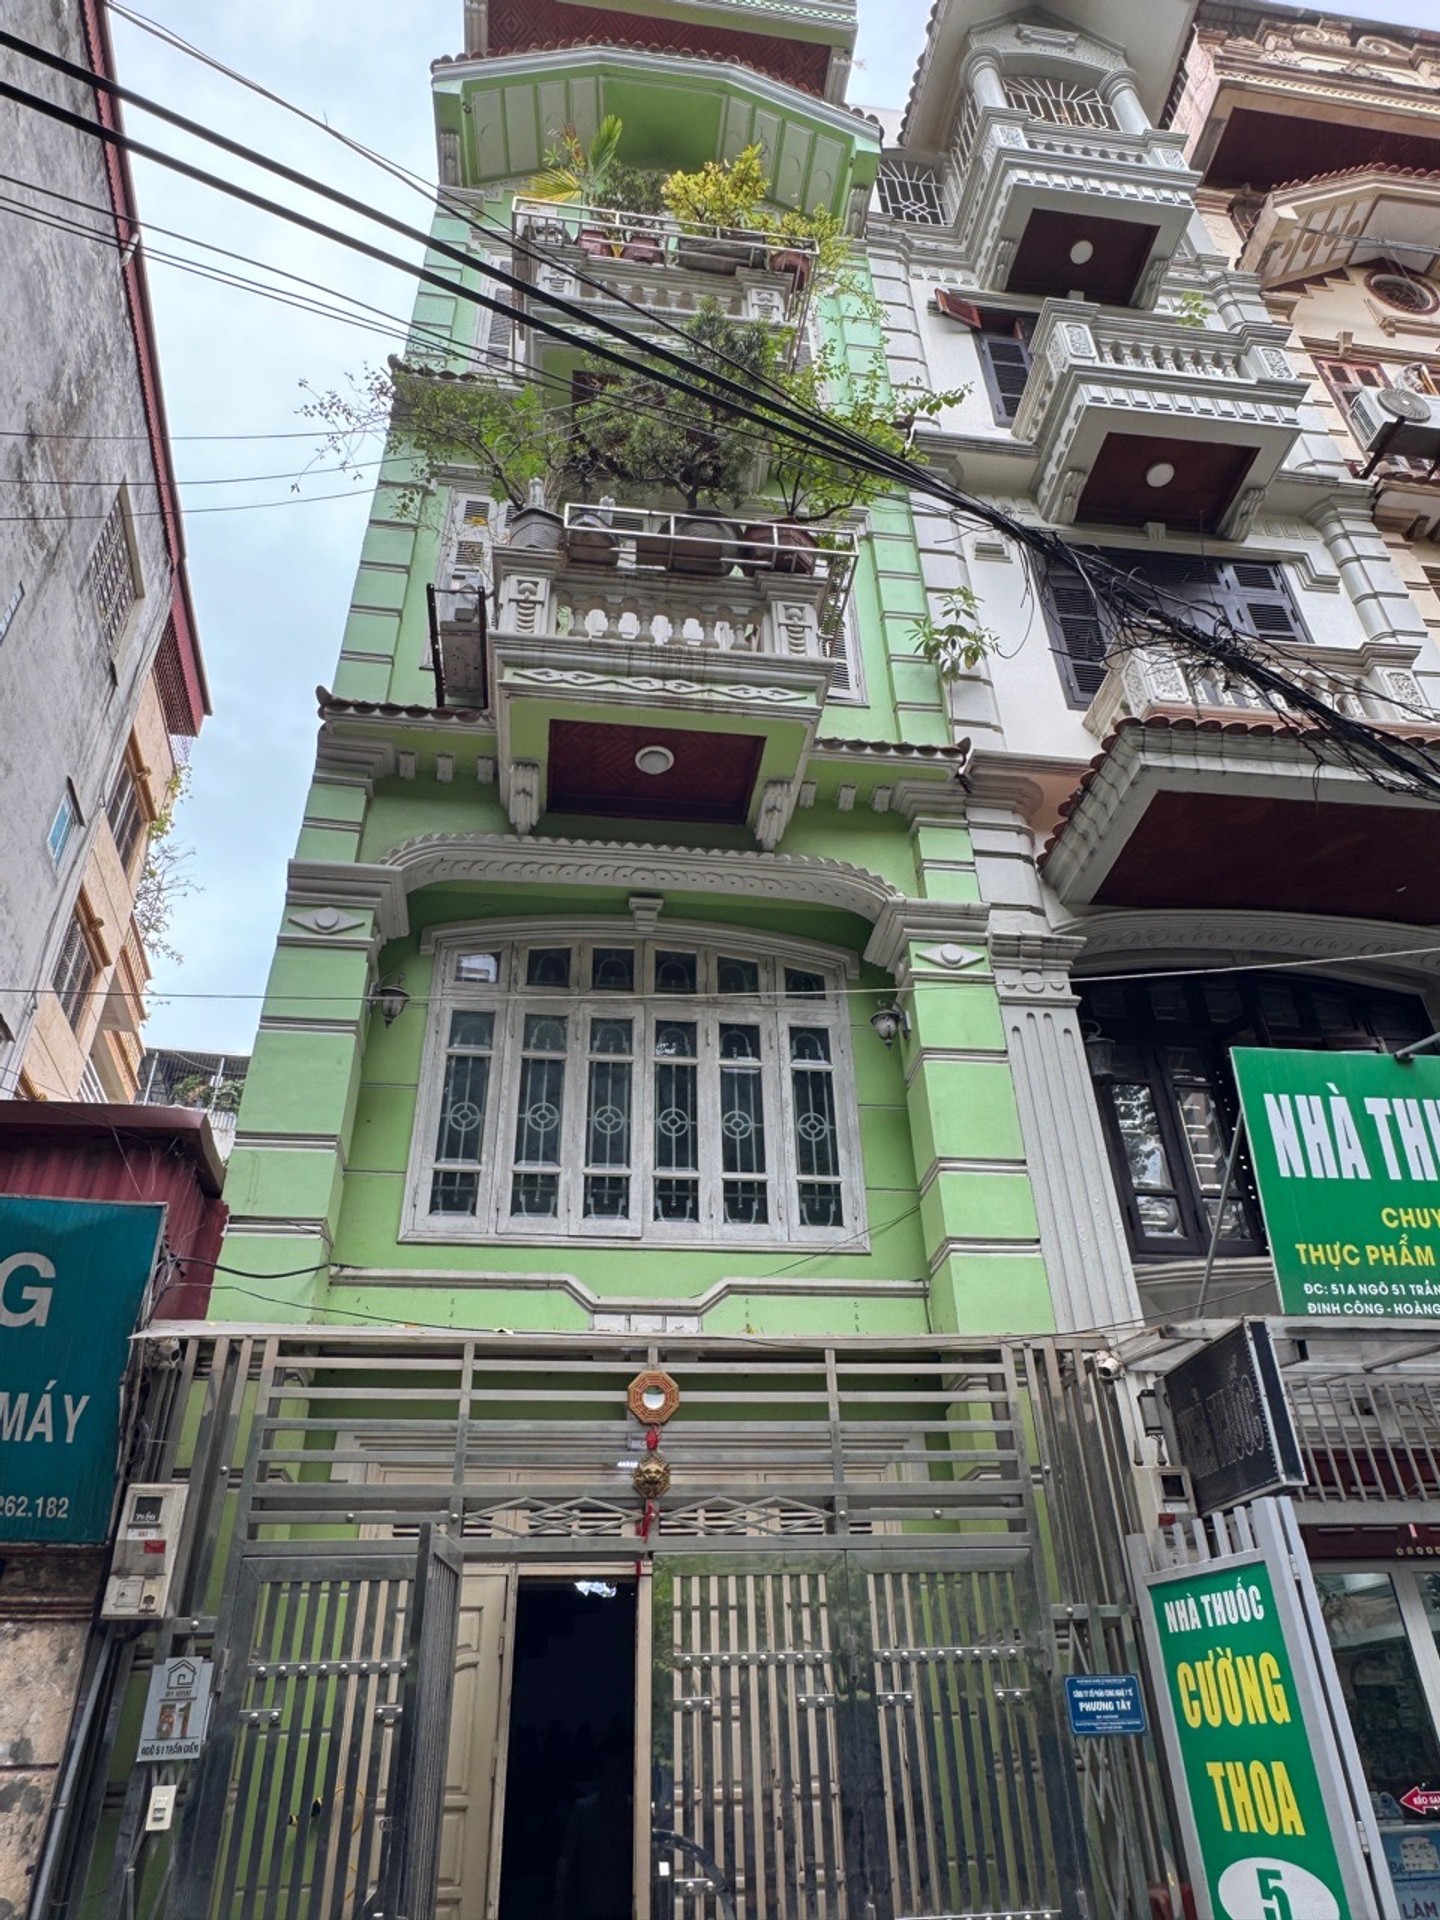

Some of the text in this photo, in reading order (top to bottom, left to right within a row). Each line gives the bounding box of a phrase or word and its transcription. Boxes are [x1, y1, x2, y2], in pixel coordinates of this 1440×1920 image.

[1263, 1082, 1372, 1180] NHÀ
[1295, 1234, 1436, 1272] THỰC PHẨM
[1303, 1283, 1329, 1295] ĐC:
[1391, 1284, 1407, 1296] 51
[1343, 1300, 1385, 1315] CÔNG
[1394, 1301, 1440, 1316] HOÀNG
[1164, 1577, 1264, 1633] NHÀ THUỐC
[1177, 1647, 1291, 1728] CƯỜNG
[158, 1702, 192, 1739] 51
[1206, 1760, 1306, 1836] THOA
